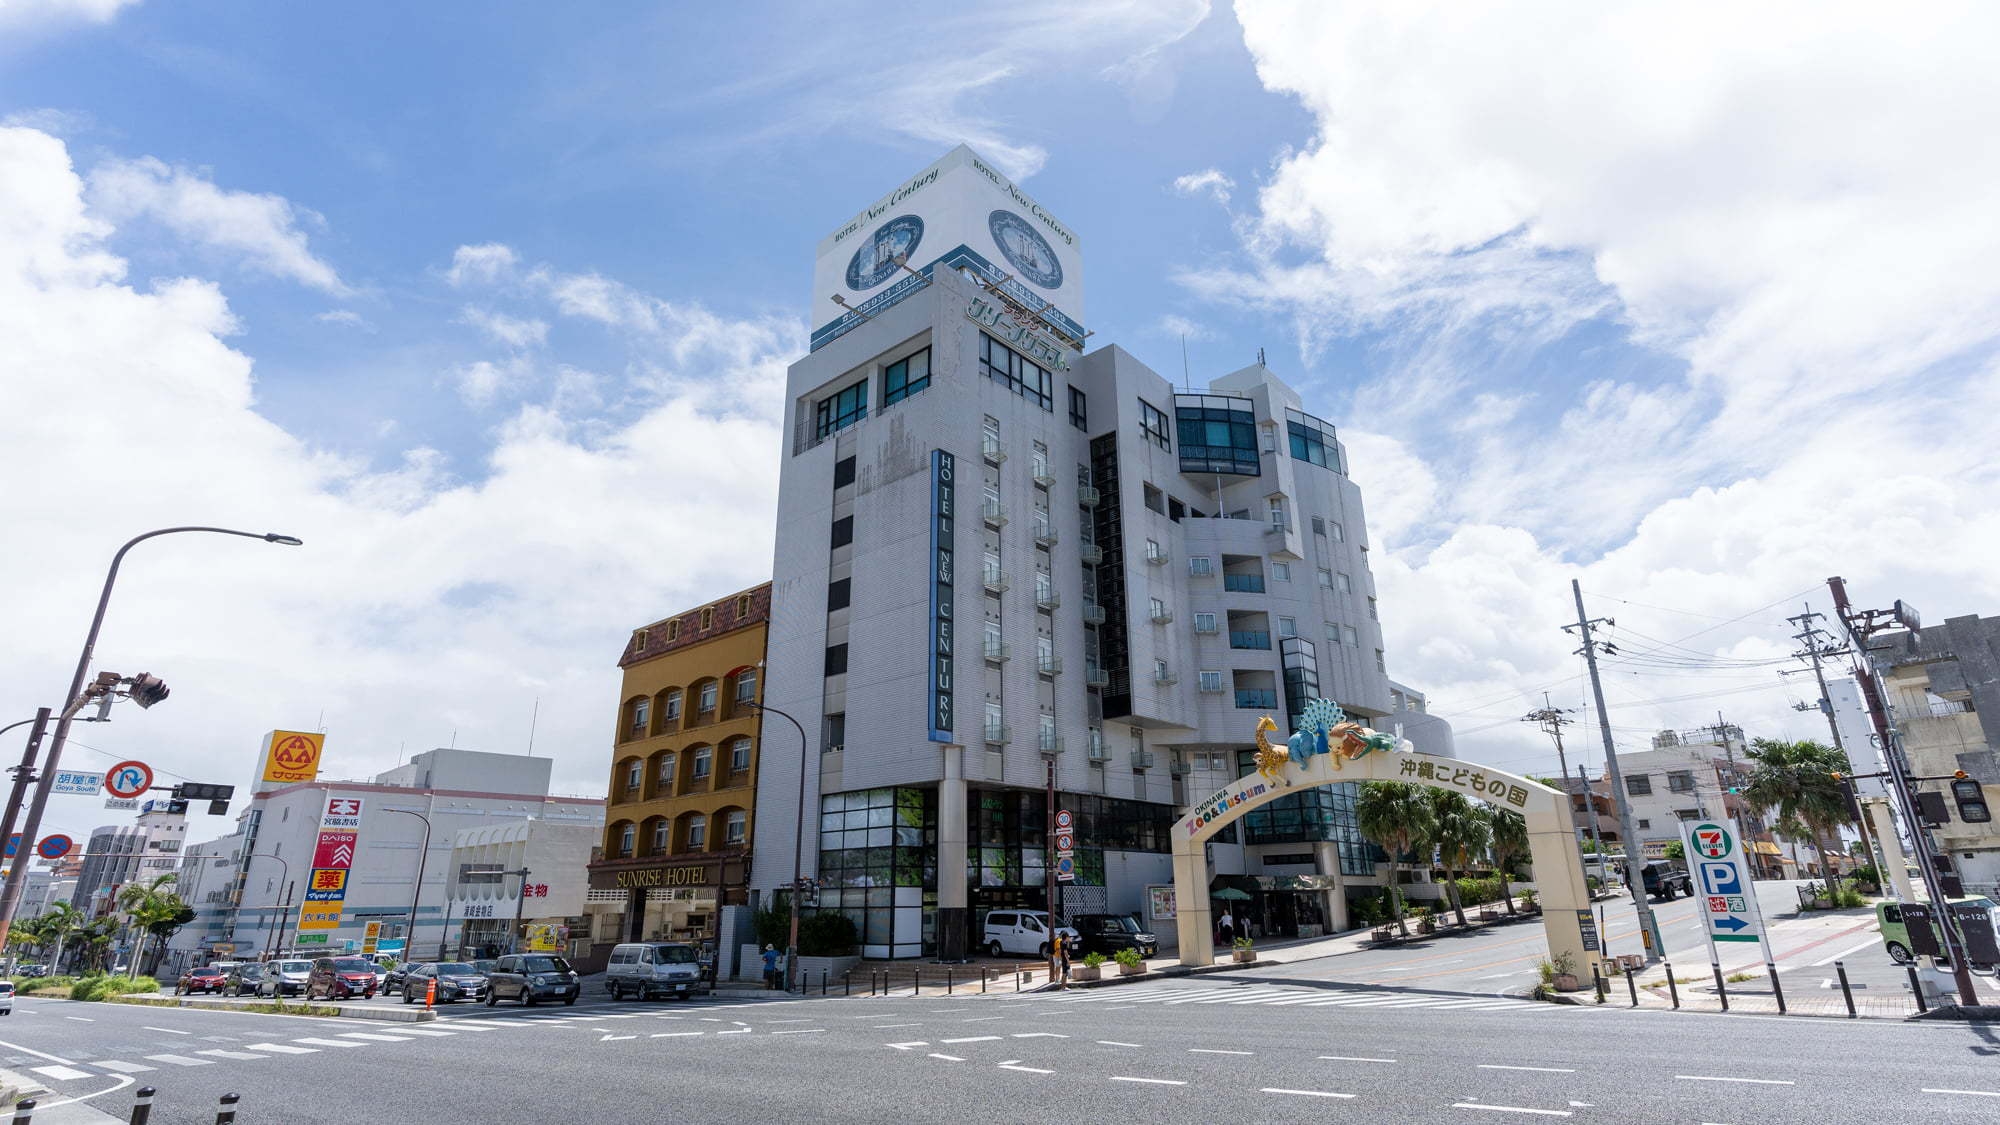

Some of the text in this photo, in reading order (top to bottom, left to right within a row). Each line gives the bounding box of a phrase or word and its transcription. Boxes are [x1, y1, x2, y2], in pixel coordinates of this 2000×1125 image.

[834, 223, 859, 243] HOTEL
[860, 201, 888, 228] New
[891, 168, 939, 206] Century
[973, 159, 1000, 185] HOTEL
[1002, 183, 1030, 208] New
[1031, 201, 1073, 245] Century
[939, 454, 952, 728] HOTEL NEW CENTURY
[272, 770, 313, 781] サンエー
[1400, 758, 1529, 808] 沖縄こどもの国
[55, 784, 74, 792] Goya
[331, 800, 358, 815] 本
[1194, 789, 1229, 815] OKINAWA
[317, 871, 342, 888] 薬
[616, 866, 706, 888] SUNRISE HOTEL
[1704, 863, 1735, 894] P
[523, 884, 549, 898] 金物
[1728, 897, 1745, 912] 酒
